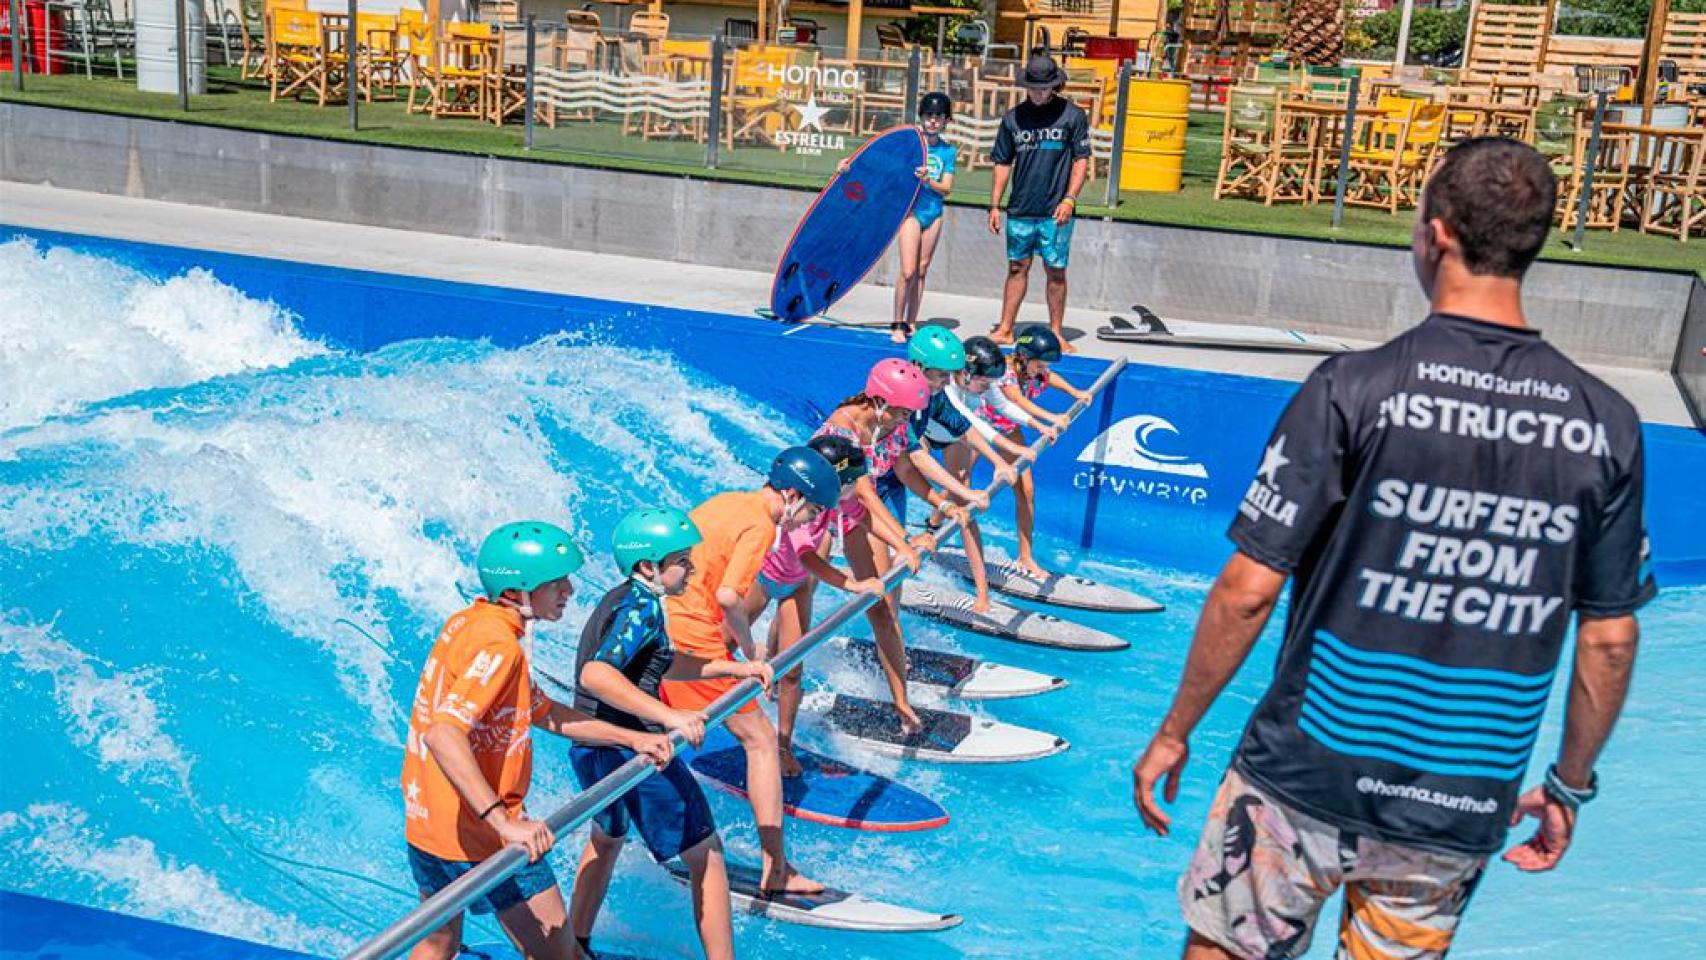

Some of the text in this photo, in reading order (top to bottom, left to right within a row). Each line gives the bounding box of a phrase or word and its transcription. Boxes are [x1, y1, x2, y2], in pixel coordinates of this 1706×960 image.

[768, 63, 858, 89] Honna
[775, 130, 844, 150] ESTRELLA
[1533, 380, 1571, 402] Hub
[1371, 478, 1579, 543] SURFERS
[1398, 531, 1539, 587] FROM
[1359, 568, 1564, 635] THE CITY
